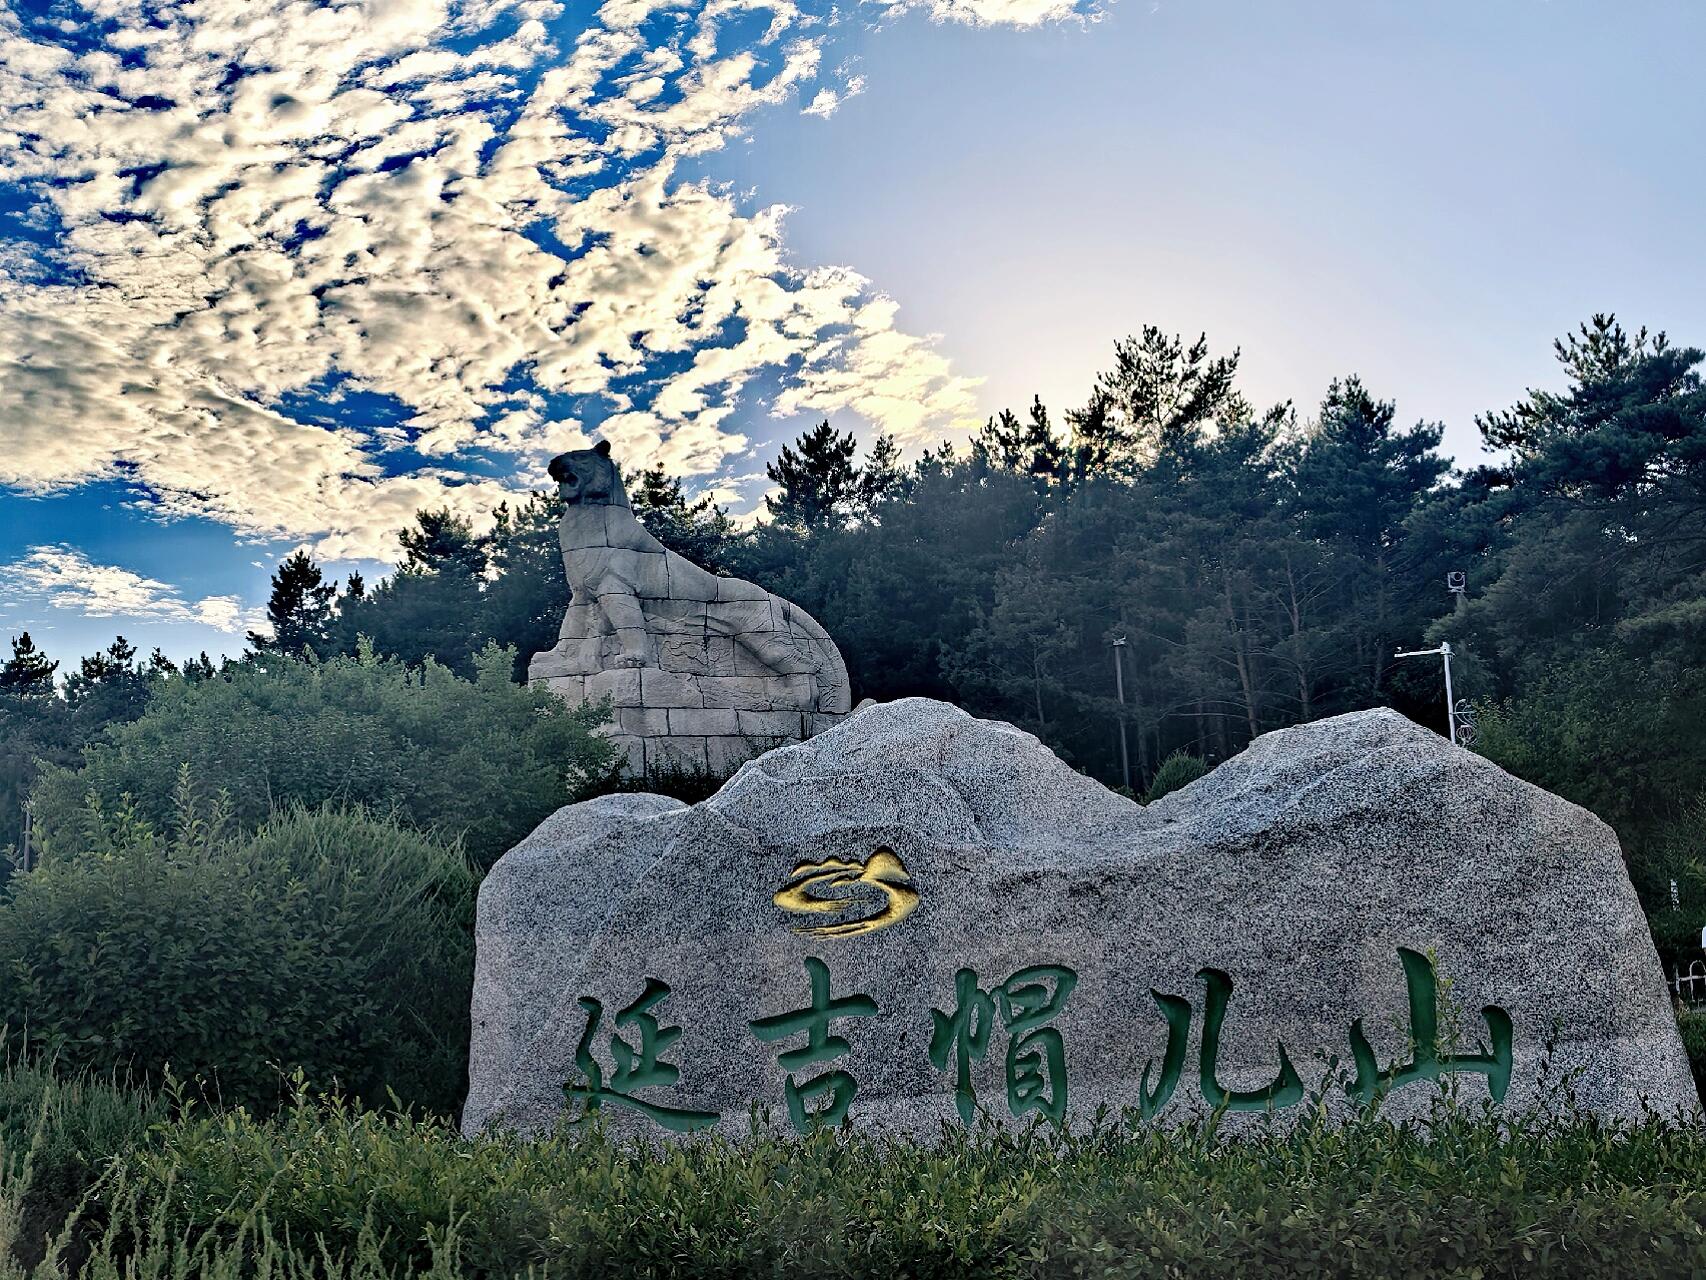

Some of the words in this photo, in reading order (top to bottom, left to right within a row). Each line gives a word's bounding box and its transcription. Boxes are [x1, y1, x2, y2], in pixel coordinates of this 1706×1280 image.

[562, 947, 1513, 1132] 延吉帽儿山
